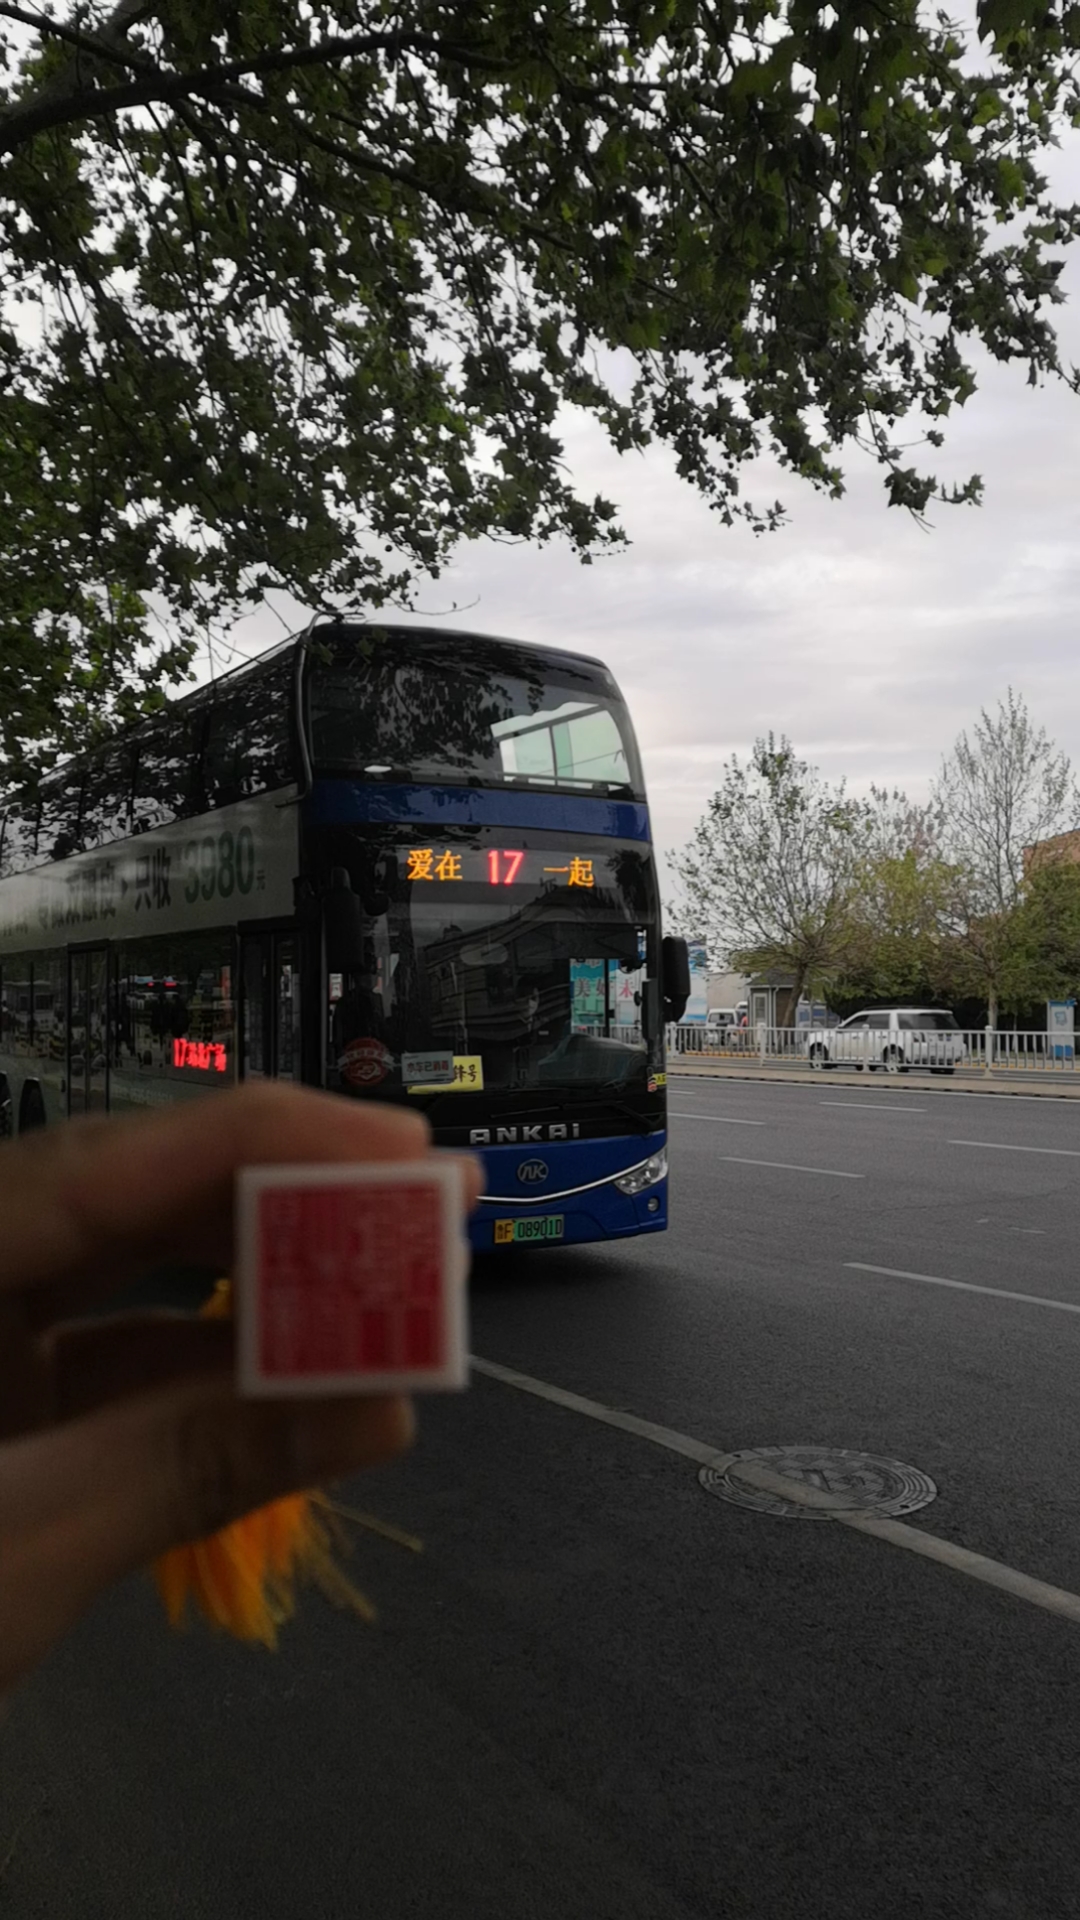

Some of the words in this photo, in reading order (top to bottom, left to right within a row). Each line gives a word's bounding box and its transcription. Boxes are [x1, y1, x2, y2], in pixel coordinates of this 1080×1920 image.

[407, 848, 463, 881] 爱在
[488, 850, 524, 884] 17
[543, 856, 595, 888] 一起
